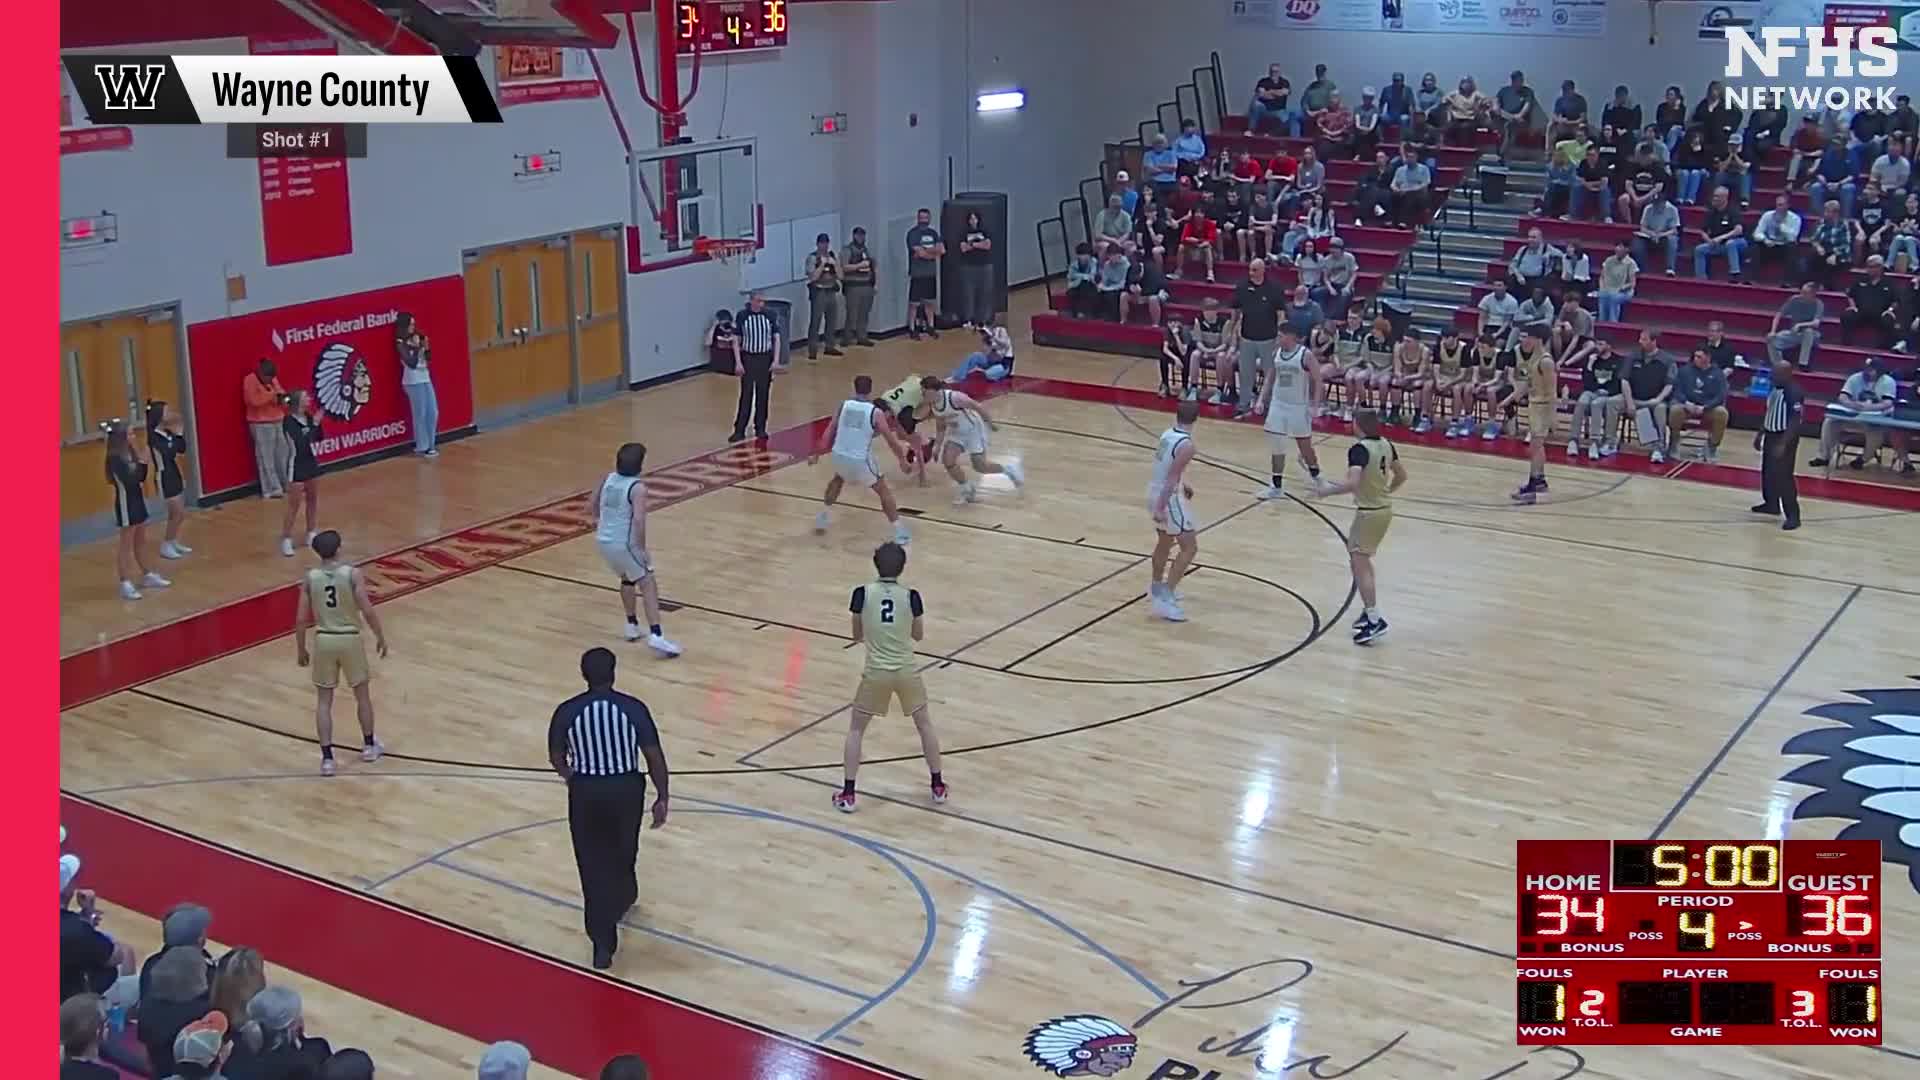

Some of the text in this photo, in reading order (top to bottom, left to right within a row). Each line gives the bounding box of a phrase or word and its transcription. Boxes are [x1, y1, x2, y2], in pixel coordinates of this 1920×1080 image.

[727, 16, 739, 45] 4
[763, 0, 785, 32] 36
[285, 308, 399, 345] First Federal Bank
[310, 420, 407, 457] WEN WARRIORS
[324, 585, 337, 608] 3
[881, 598, 894, 623] 2
